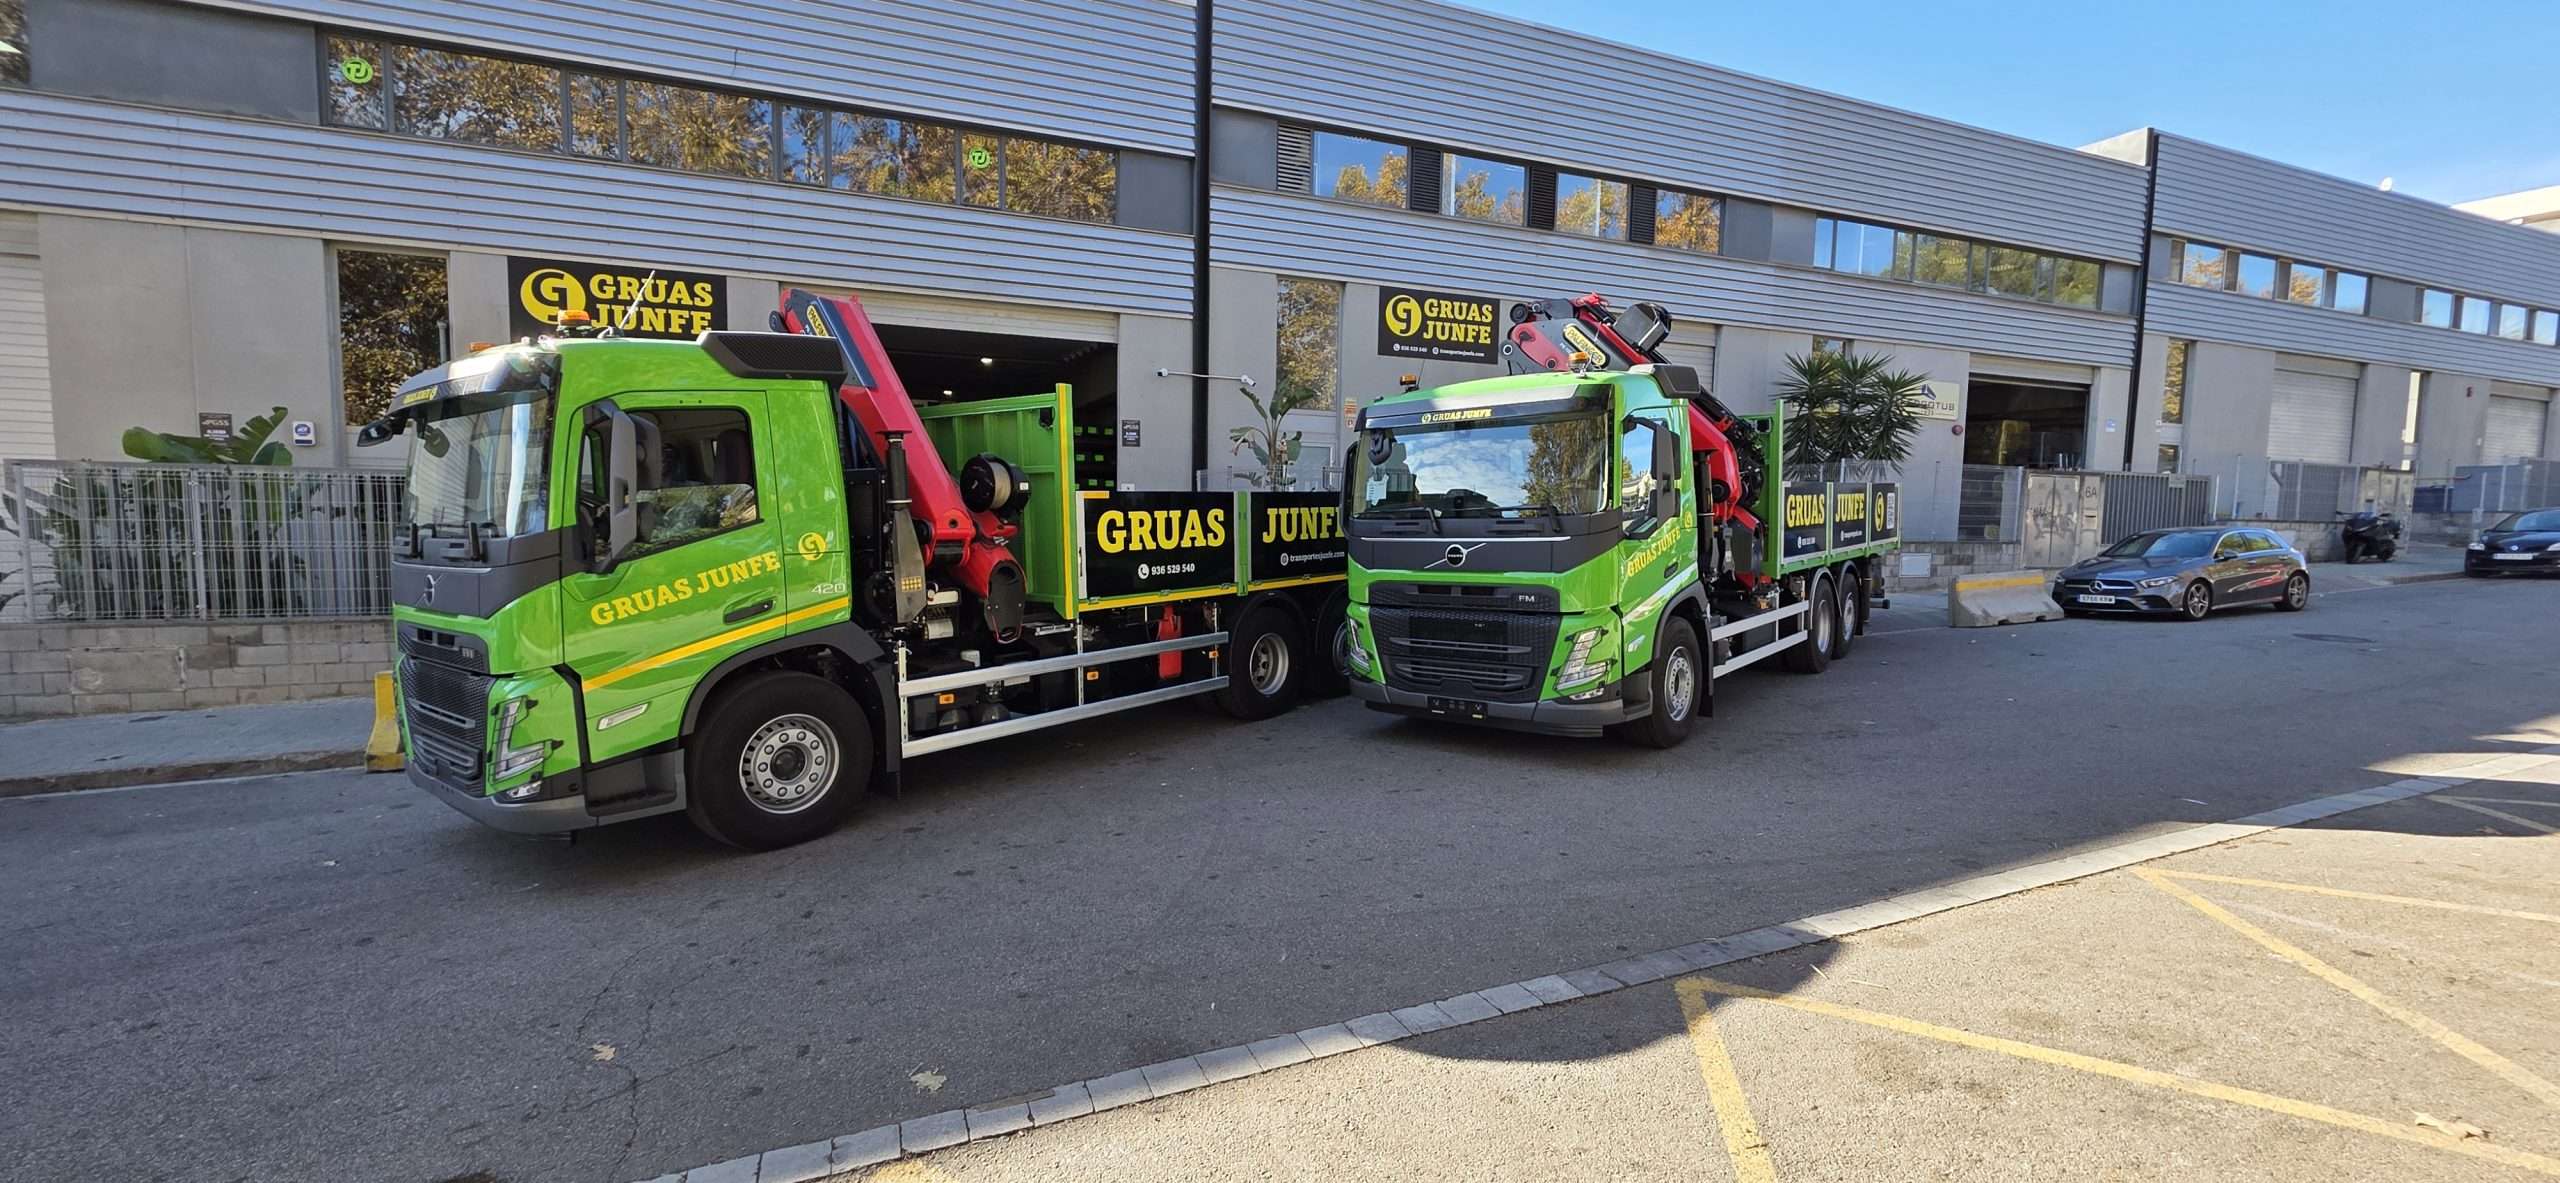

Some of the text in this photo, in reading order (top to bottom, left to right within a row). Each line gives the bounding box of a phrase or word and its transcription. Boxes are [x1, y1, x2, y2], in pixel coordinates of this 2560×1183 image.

[589, 274, 713, 307] GRUAS
[591, 303, 712, 335] JUNFE
[1424, 298, 1493, 323] GRUAS
[1423, 320, 1491, 344] JUNFE
[1432, 411, 1461, 422] GRUAS
[1787, 493, 1825, 528] GRUAS
[1836, 493, 1864, 522] JUNFE
[1097, 508, 1225, 554] GRUAS
[1151, 563, 1195, 576] 936 529 540
[1627, 542, 1657, 577] GRUAS
[591, 551, 780, 625] GRUAS JUNFE
[811, 583, 846, 594] 420
